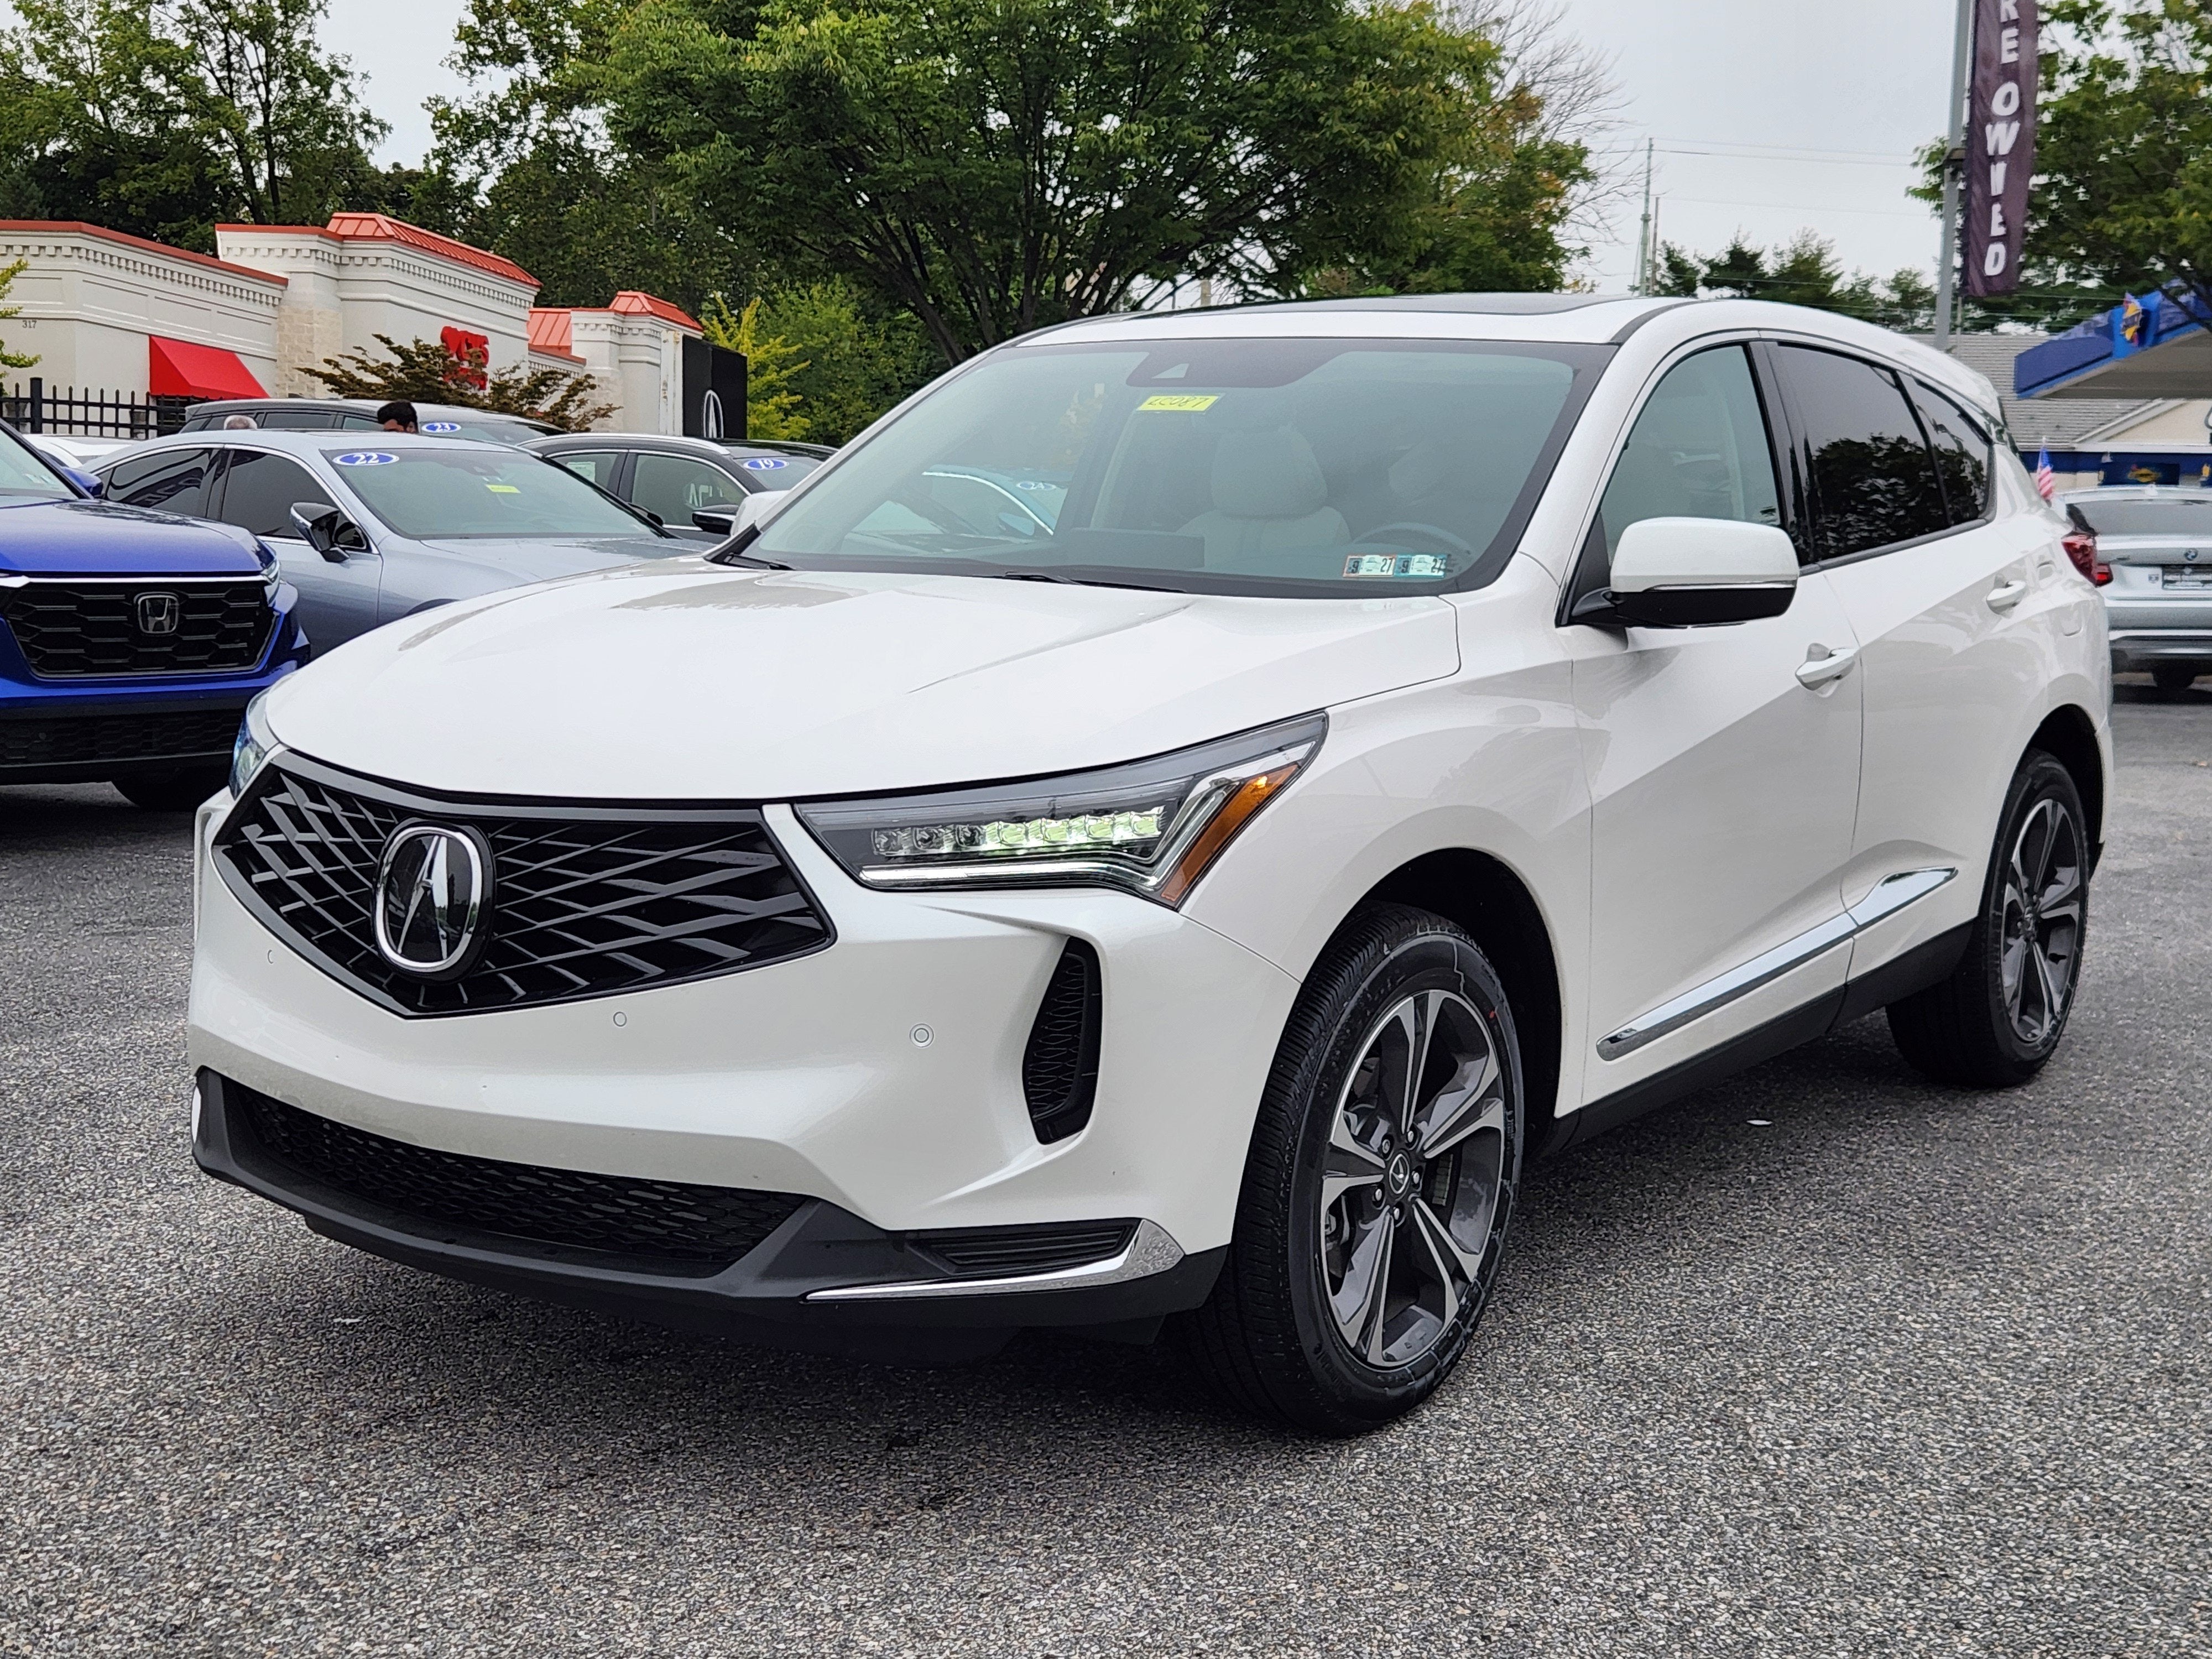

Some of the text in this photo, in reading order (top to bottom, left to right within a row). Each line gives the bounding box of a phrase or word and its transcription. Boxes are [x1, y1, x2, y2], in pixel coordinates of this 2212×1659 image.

[22, 320, 37, 328] 317
[353, 452, 380, 465] 22
[758, 458, 775, 469] 19
[1380, 557, 1395, 573] 27
